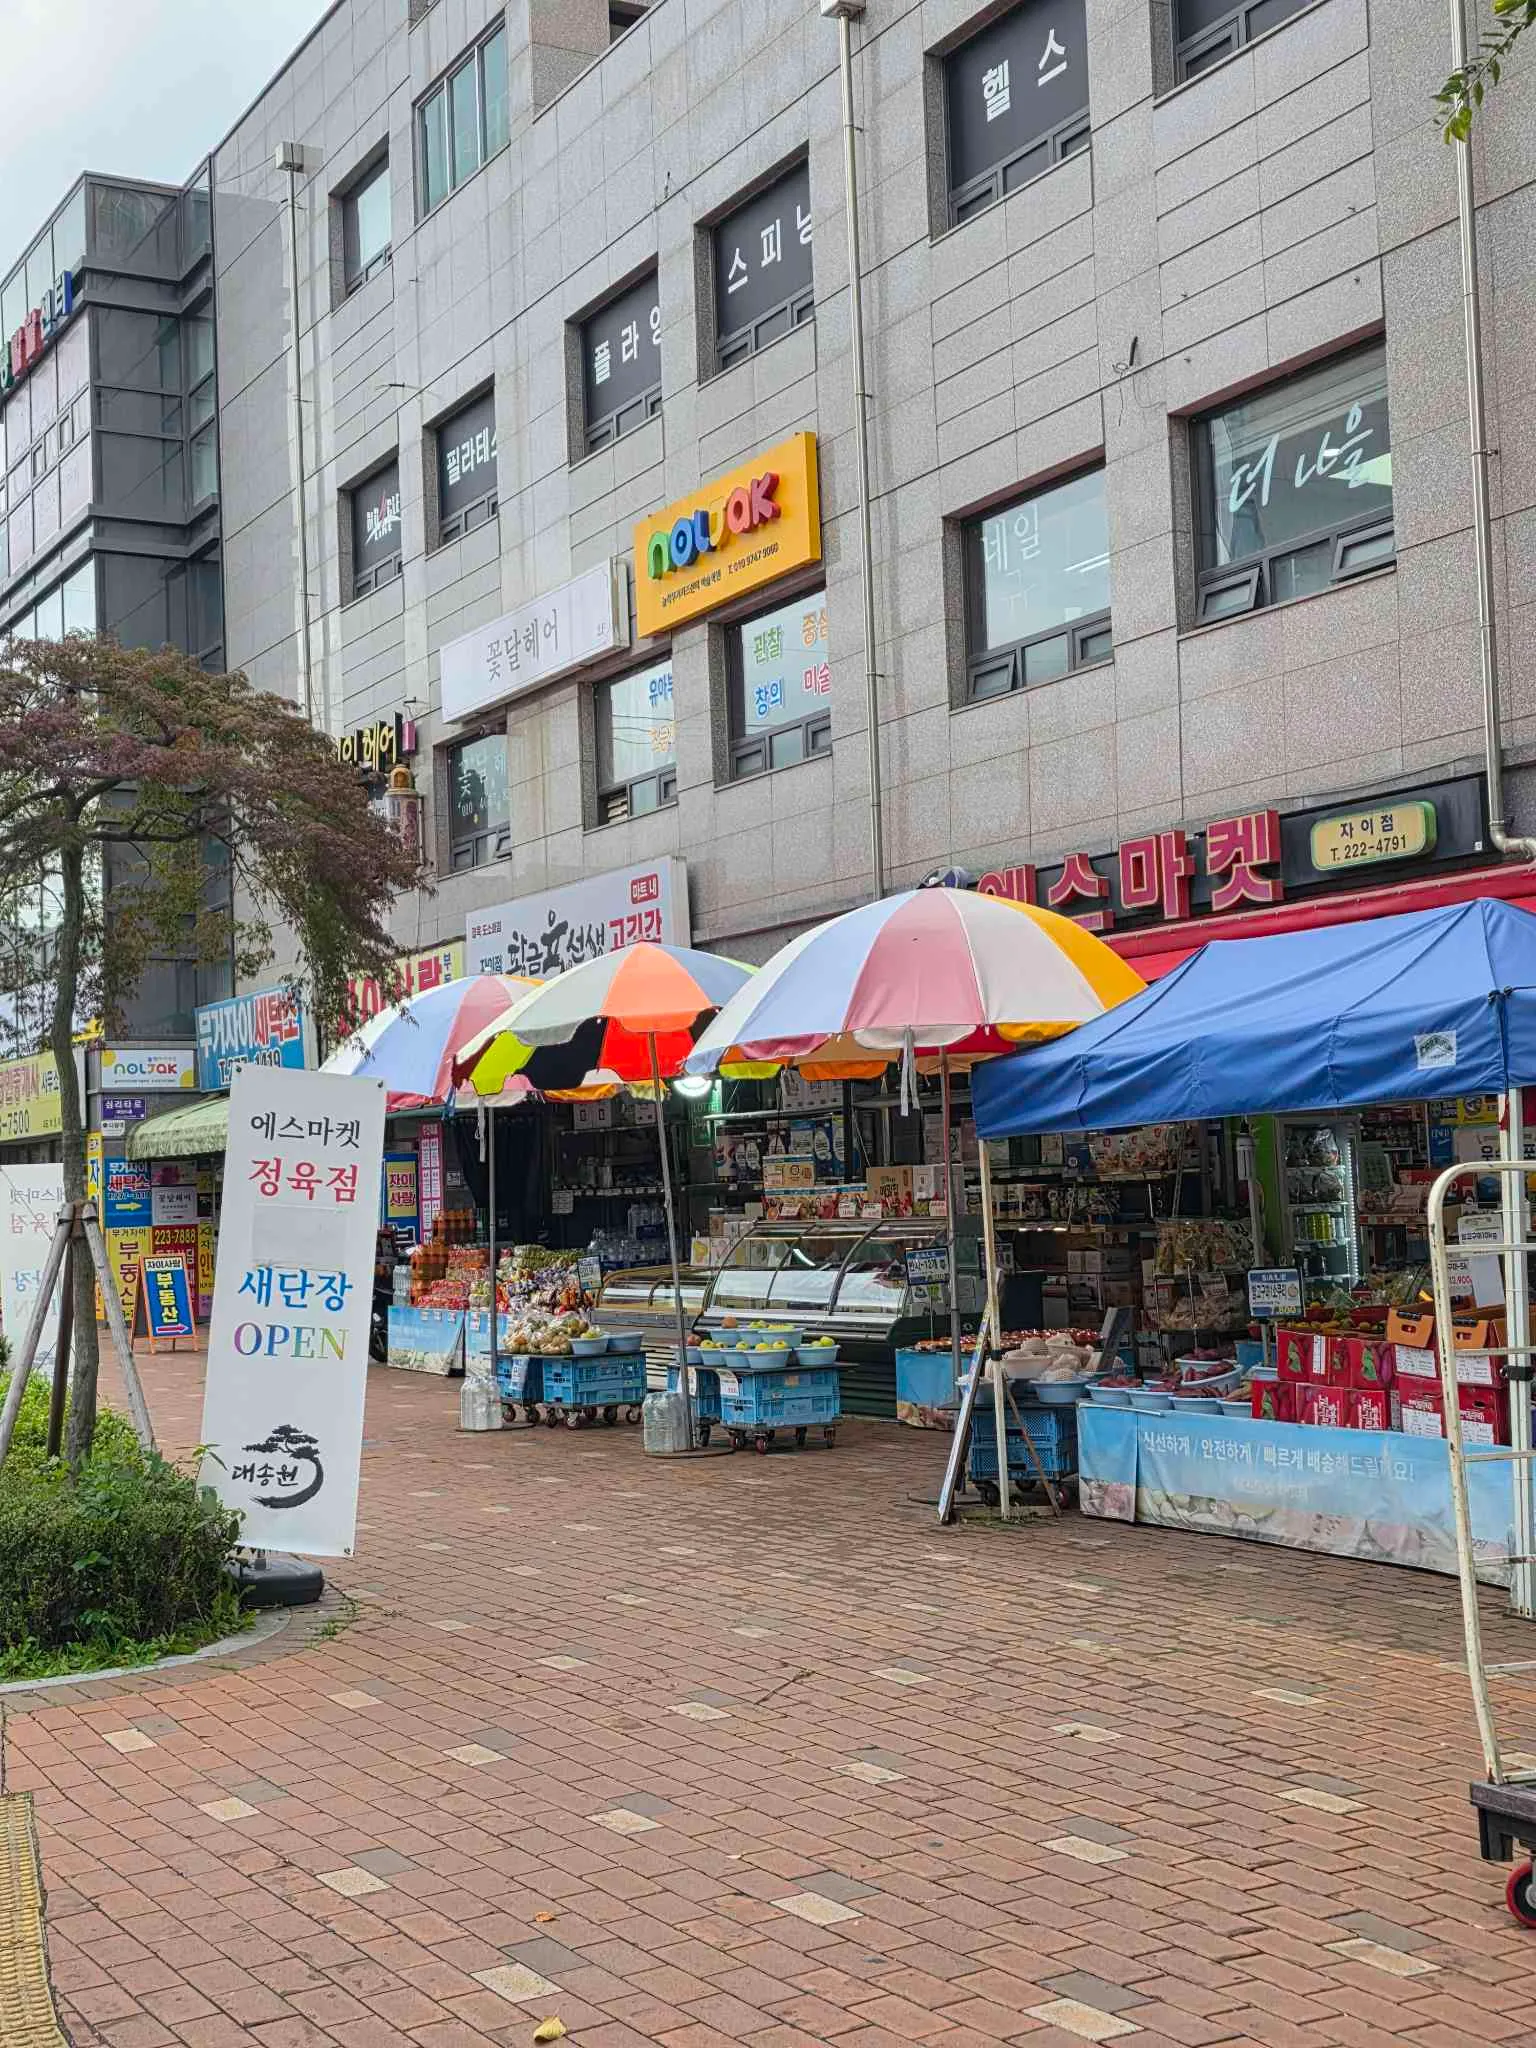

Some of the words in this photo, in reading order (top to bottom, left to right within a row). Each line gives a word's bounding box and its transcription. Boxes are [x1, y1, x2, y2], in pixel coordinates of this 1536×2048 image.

[982, 29, 1067, 122] 헬스
[487, 608, 558, 681] 꽃달헤어
[754, 623, 783, 664] 관찰
[755, 679, 783, 720] 창의
[803, 663, 829, 696] 미술
[1340, 814, 1394, 840] 자이점
[1344, 834, 1407, 859] 222-4791
[977, 810, 1287, 932] 에스마켓
[0, 1109, 30, 1135] -7500
[250, 1111, 361, 1149] 에스마켓
[248, 1156, 358, 1203] 정육점
[156, 1271, 180, 1324] 부동산
[238, 1265, 354, 1312] 새단장
[233, 1322, 350, 1361] OPEN
[1142, 1430, 1191, 1458] 신선하게
[1201, 1438, 1251, 1465] 안전하게
[1263, 1446, 1304, 1472] 빠르게
[231, 1462, 299, 1487] 대송원
